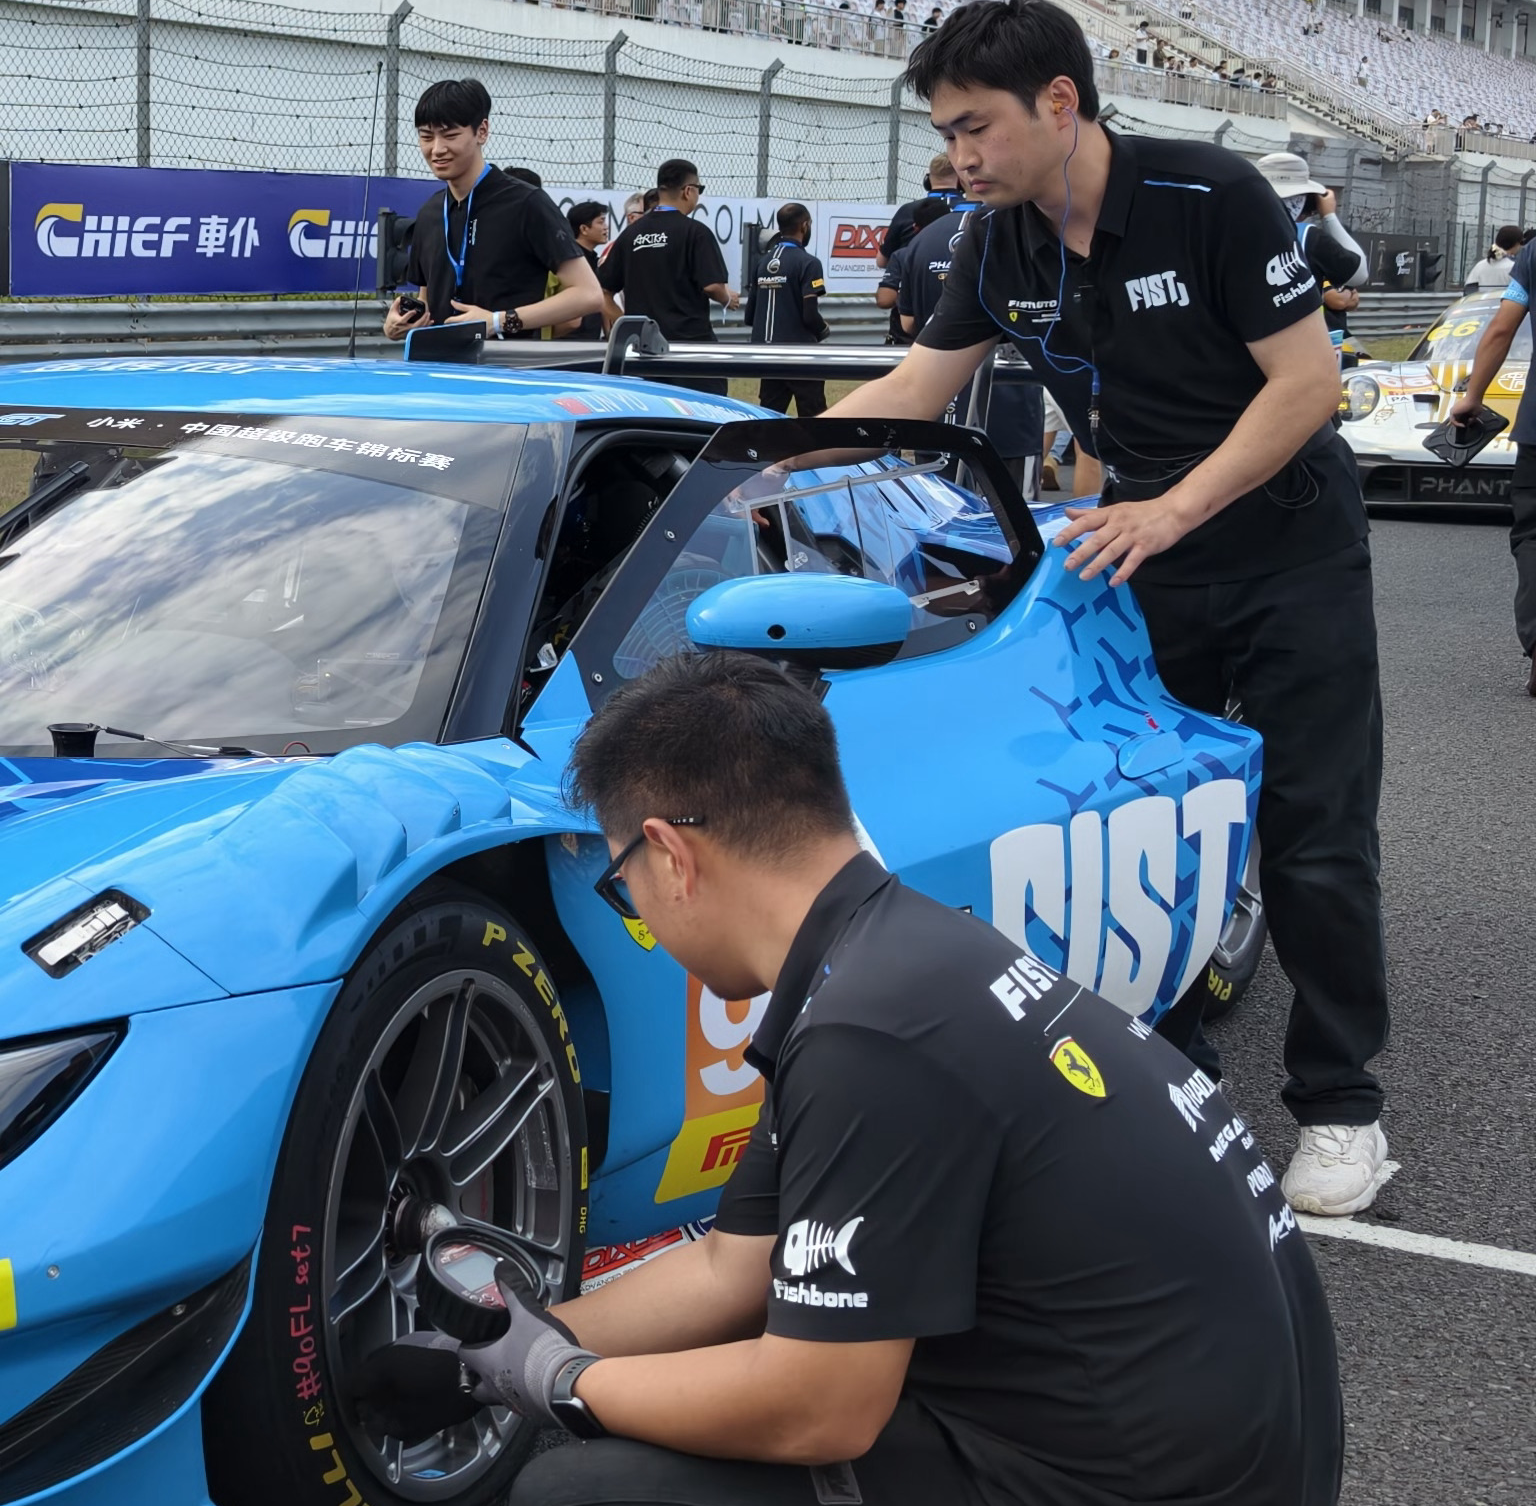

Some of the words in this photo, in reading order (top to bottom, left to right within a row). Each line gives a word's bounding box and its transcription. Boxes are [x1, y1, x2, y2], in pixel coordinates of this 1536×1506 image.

[35, 202, 191, 258] CHIEF
[195, 214, 261, 258] 車仆
[288, 208, 379, 258] CHI
[1427, 321, 1480, 342] 66
[86, 416, 147, 430] 小米
[180, 422, 455, 472] 中国超级跑车锦标赛
[1420, 477, 1511, 496] PHANT
[482, 921, 507, 947] P
[512, 940, 581, 1085] ZERO
